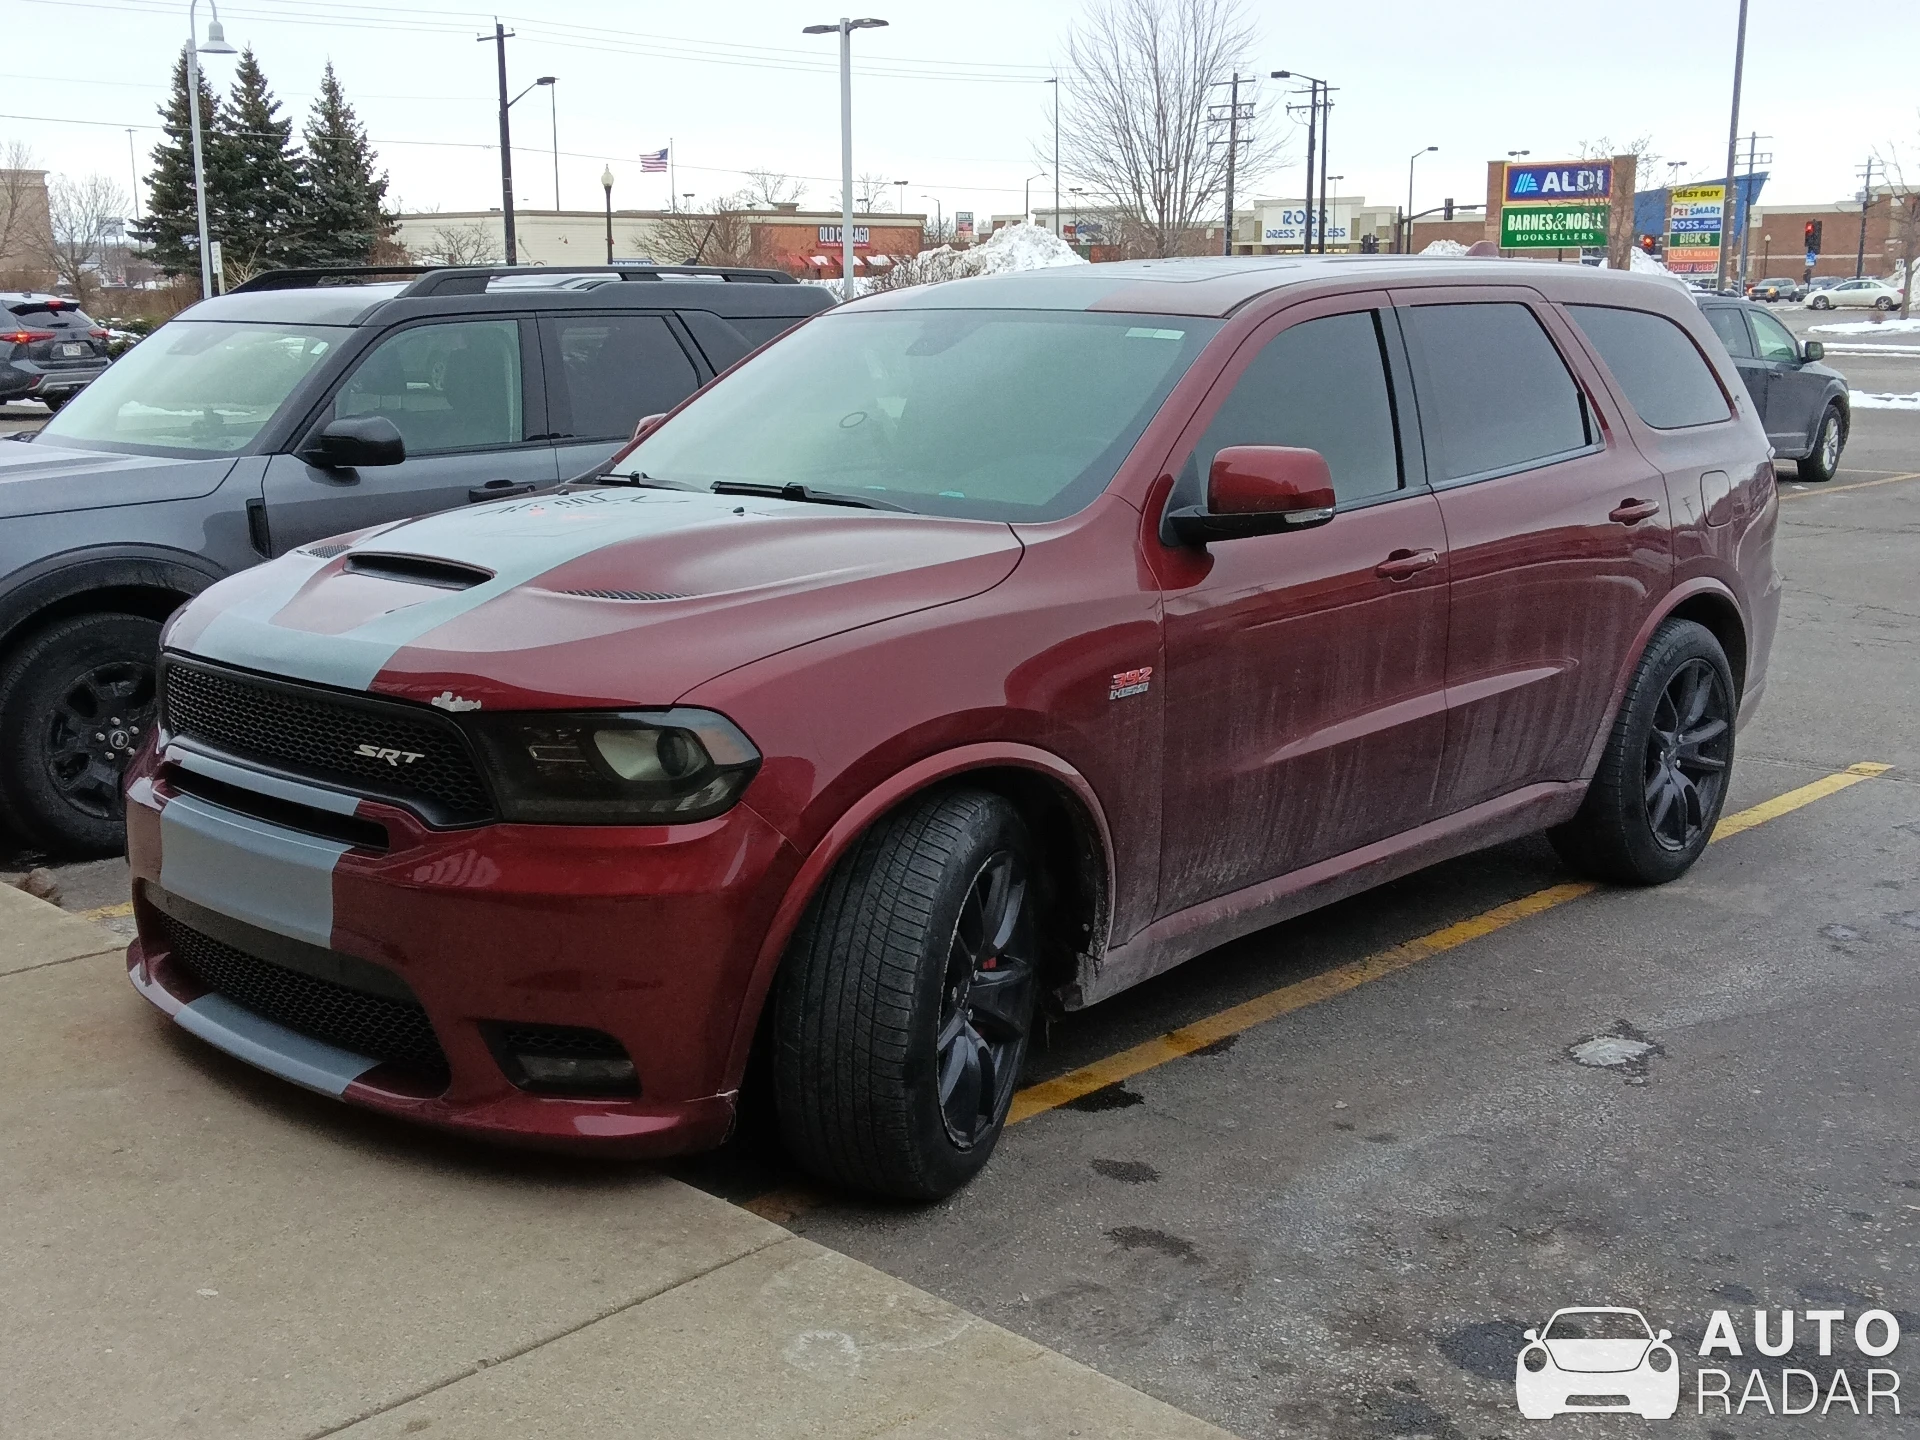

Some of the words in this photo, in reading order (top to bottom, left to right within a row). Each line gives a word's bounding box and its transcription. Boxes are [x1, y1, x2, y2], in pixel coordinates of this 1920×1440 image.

[1541, 170, 1604, 192] ALDI
[1265, 229, 1296, 239] DRESS
[1298, 228, 1318, 238] FR
[1672, 220, 1700, 230] ROSS
[819, 226, 835, 242] OLD
[836, 226, 870, 243] CAGO
[1516, 232, 1594, 241] BOOKSELLERS
[1680, 232, 1711, 244] DICK'S
[1110, 666, 1153, 690] 392
[1109, 682, 1149, 700] HEMI
[353, 744, 425, 766] SRT
